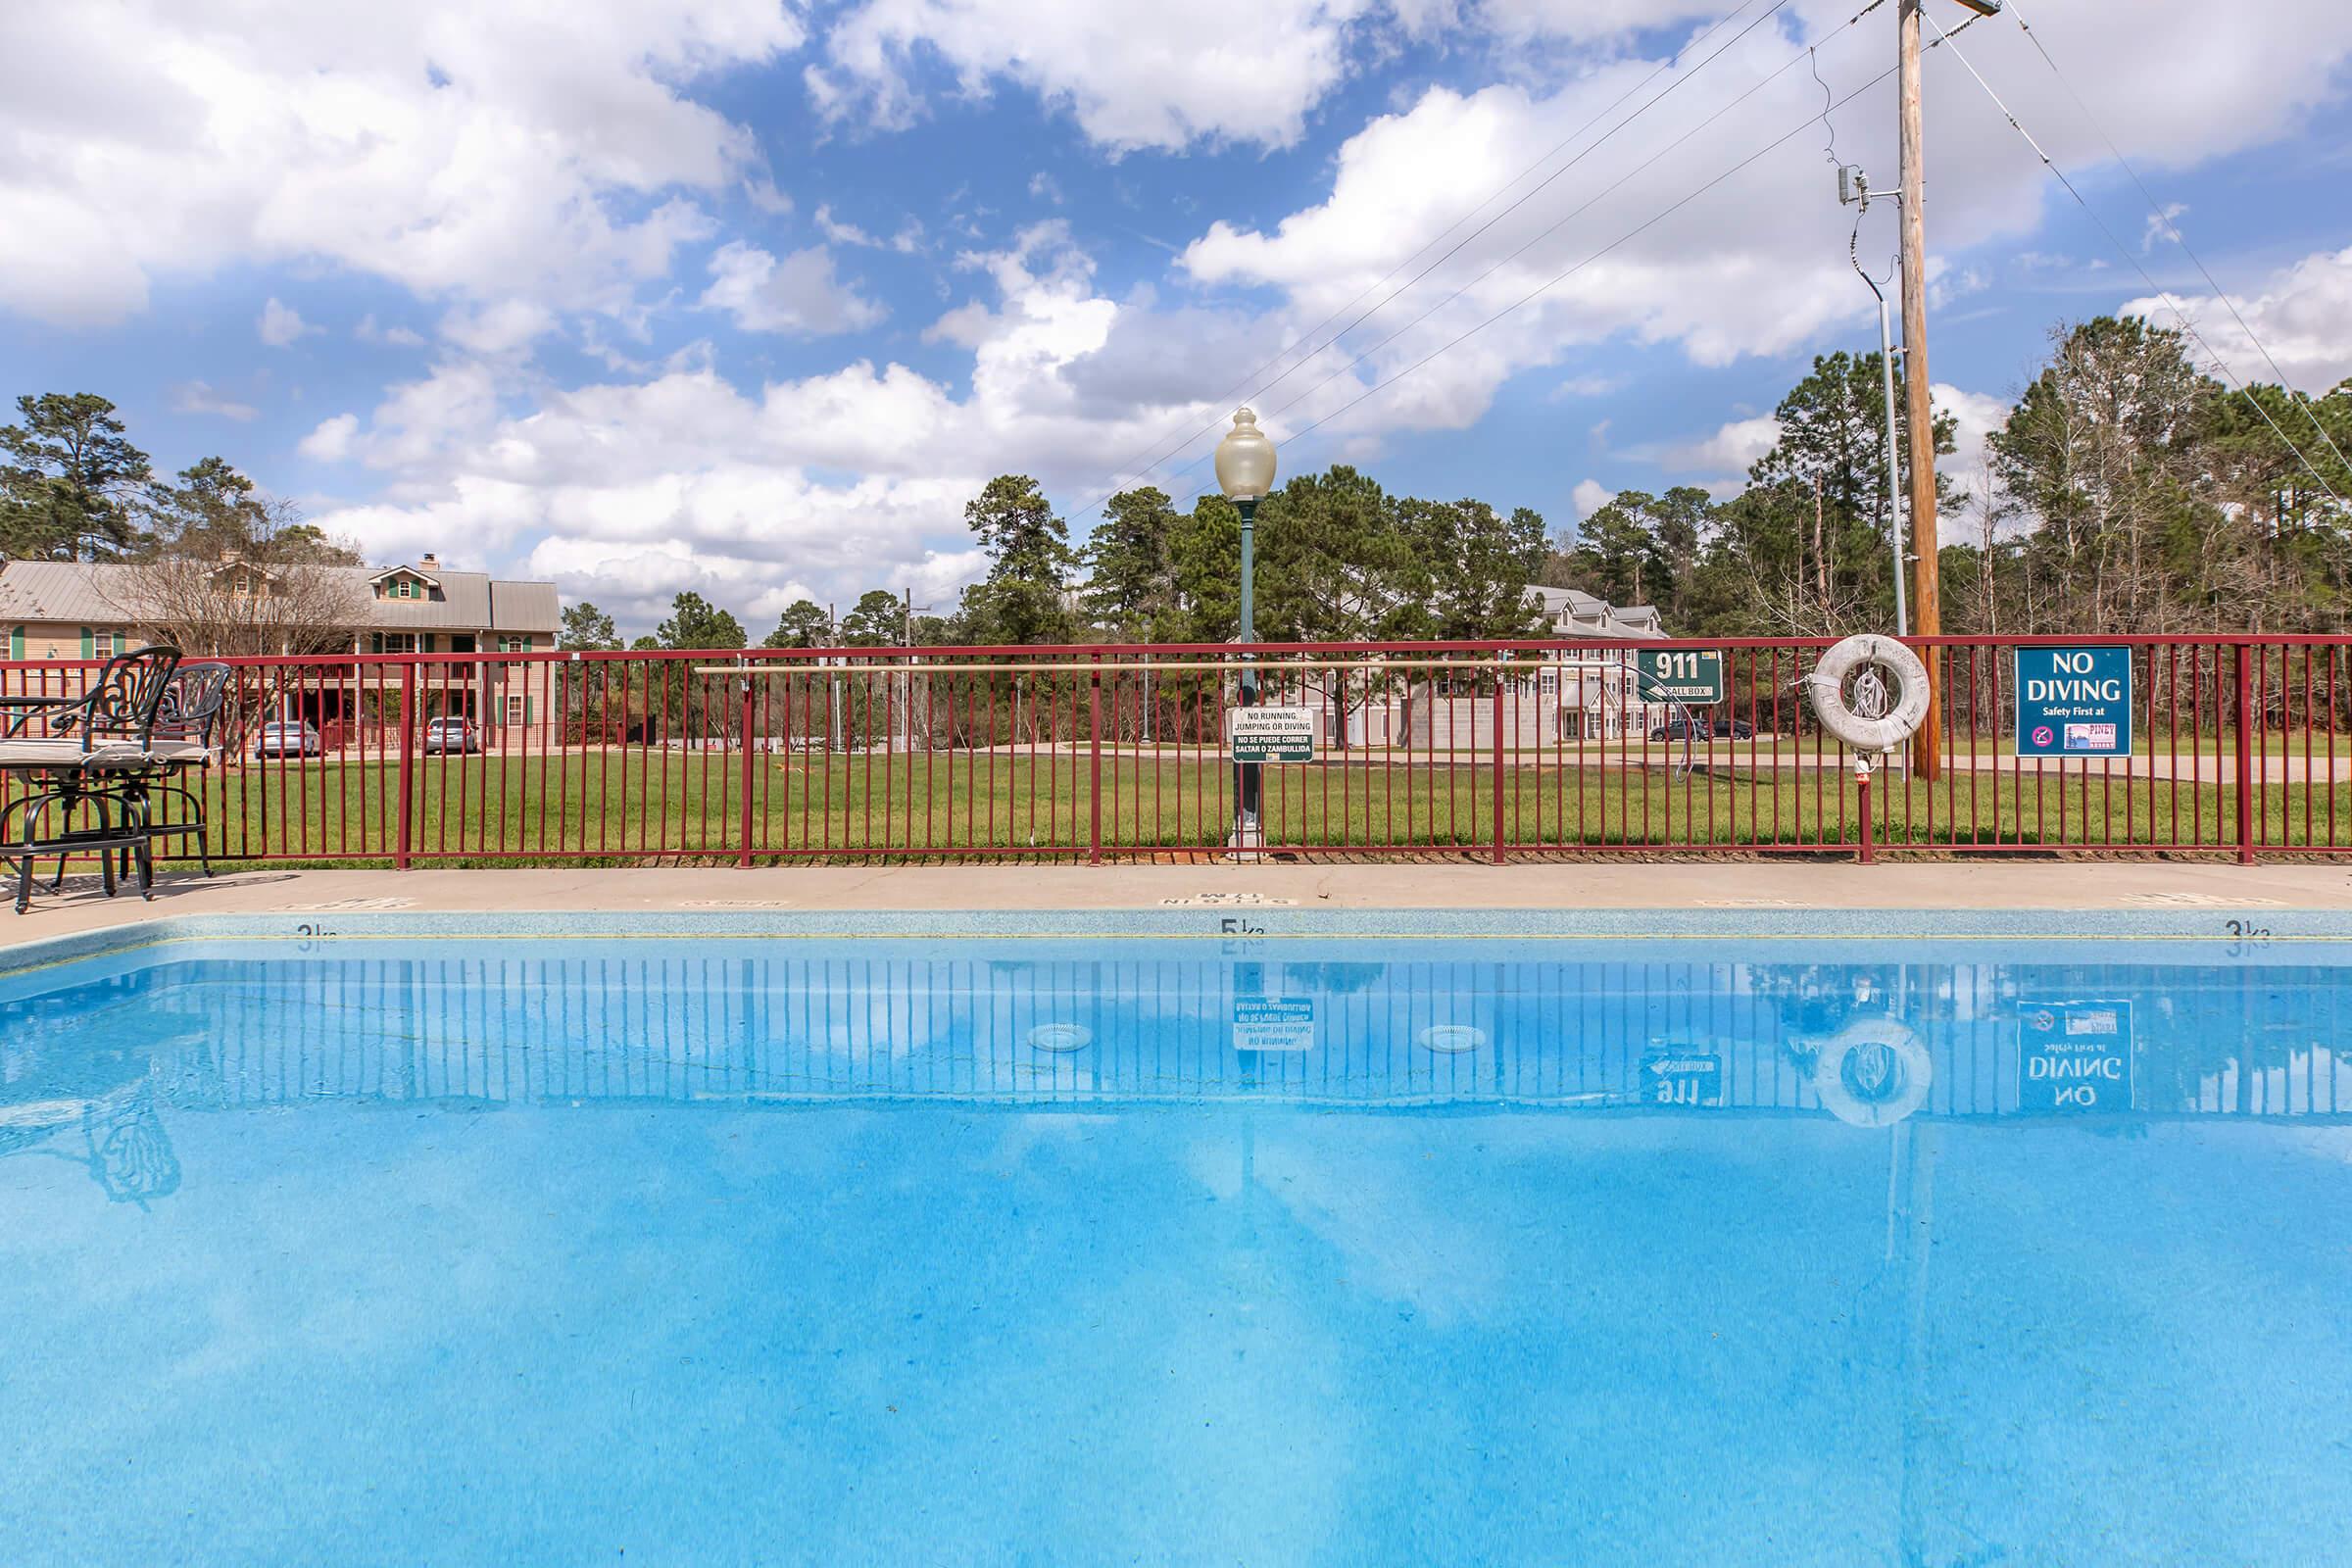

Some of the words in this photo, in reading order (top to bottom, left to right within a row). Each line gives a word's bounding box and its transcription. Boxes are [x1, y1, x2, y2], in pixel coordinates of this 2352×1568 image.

[1656, 652, 1697, 679] 911
[2053, 652, 2093, 673] NO
[2028, 679, 2121, 701] DIVING
[2043, 706, 2070, 717] Safety
[2074, 706, 2092, 715] First
[2095, 707, 2105, 715] at
[2089, 725, 2115, 734] PINEY
